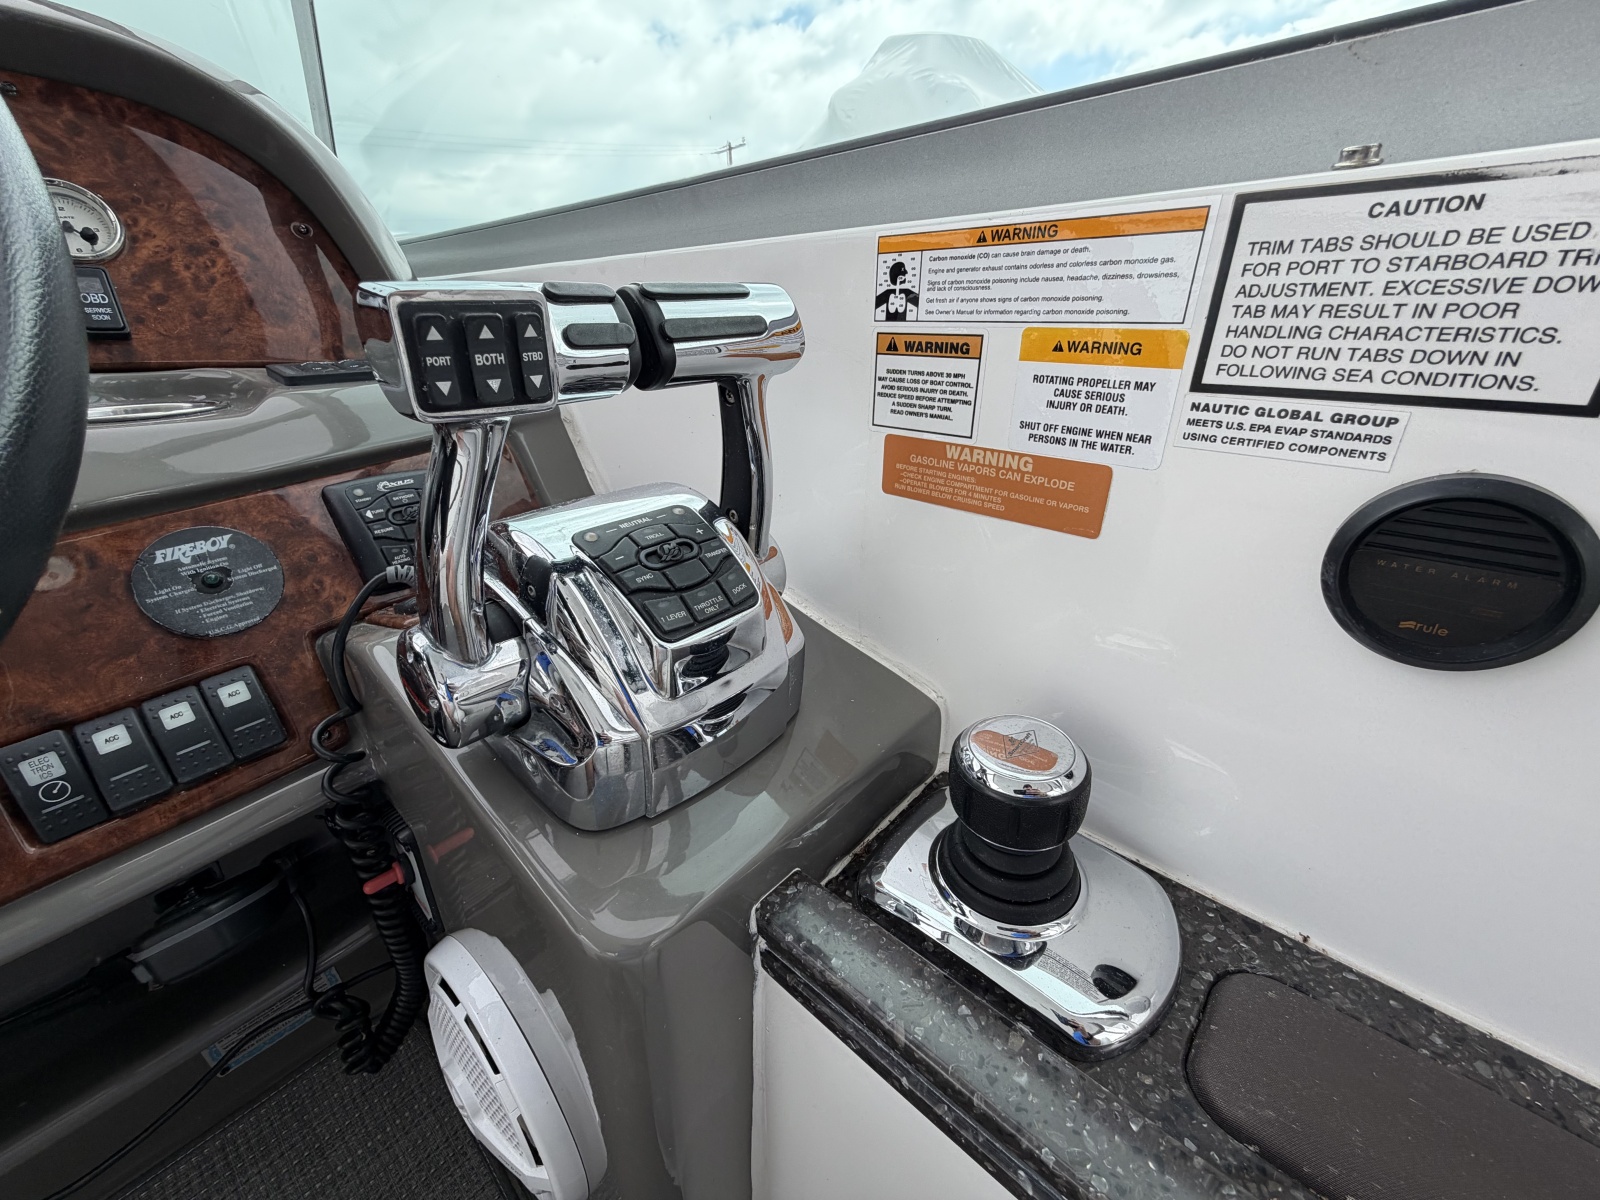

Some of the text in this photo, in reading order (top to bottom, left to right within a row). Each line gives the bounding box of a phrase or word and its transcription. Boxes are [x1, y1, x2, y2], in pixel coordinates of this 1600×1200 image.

[1366, 193, 1487, 218] CAUTION
[991, 224, 1058, 242] WARNING
[1247, 221, 1593, 255] TRIM TABS SHOULD BE USED
[1036, 248, 1060, 256] damage
[1239, 248, 1599, 277] FOR PORT TO STARBOARD TRI
[1234, 274, 1599, 298] ADJUSTMENT. EXCESSIVE DOW
[80, 293, 108, 304] OBD
[1230, 302, 1521, 318] TAB MAY RESULT IN POOR
[1224, 324, 1564, 343] HANDLING CHARACTERISTICS.
[904, 340, 970, 355] WARNING
[1066, 339, 1143, 355] WARNING
[1219, 344, 1524, 366] DO NOT RUN TABS DOWN IN
[426, 356, 451, 366] PORT
[475, 353, 505, 366] BOTH
[522, 352, 543, 361] STBD
[1031, 374, 1155, 391] ROTATING PROPELLER MAY
[1214, 363, 1541, 391] FOLLOWING SEA CONDITIONS.
[937, 397, 973, 405] ATTEMPTING
[1053, 388, 1124, 402] CAUSE SERIOUS
[1045, 399, 1128, 415] INJURY OR DEATH.
[1189, 401, 1399, 428] NAUTIC GLOBAL GROUP
[1018, 420, 1152, 444] SHUT OFF ENGINE WHEN NEAR
[1185, 417, 1393, 444] MEETS U.S. EPA EVAP STANDARDS
[1027, 432, 1134, 454] PERSONS IN THE WATER.
[1181, 432, 1388, 461] USING CERTIFIED COMPONENTS
[946, 444, 1034, 472] WARNING
[910, 454, 1075, 491] GASOLINE VAPORS CAN EXPLODE
[907, 486, 930, 494] BLOWER
[931, 491, 951, 499] BELOW
[953, 496, 982, 506] CRUISING
[984, 503, 1004, 511] SPEED
[618, 517, 652, 529] NEUTRAL
[645, 532, 664, 540] TROLL
[635, 573, 654, 583] SYNC
[1377, 559, 1518, 589] WATER ALARM
[732, 583, 747, 595] DOCK
[693, 596, 723, 612] THROTTLE
[704, 604, 720, 614] ONLY
[666, 611, 687, 621] LEVER
[1415, 623, 1448, 637] rule
[228, 690, 240, 698] ACC
[170, 711, 183, 720] ACC
[104, 734, 120, 744] ACC
[28, 756, 50, 769] ELEC
[30, 762, 54, 776] TRON
[39, 770, 54, 780] ICS
